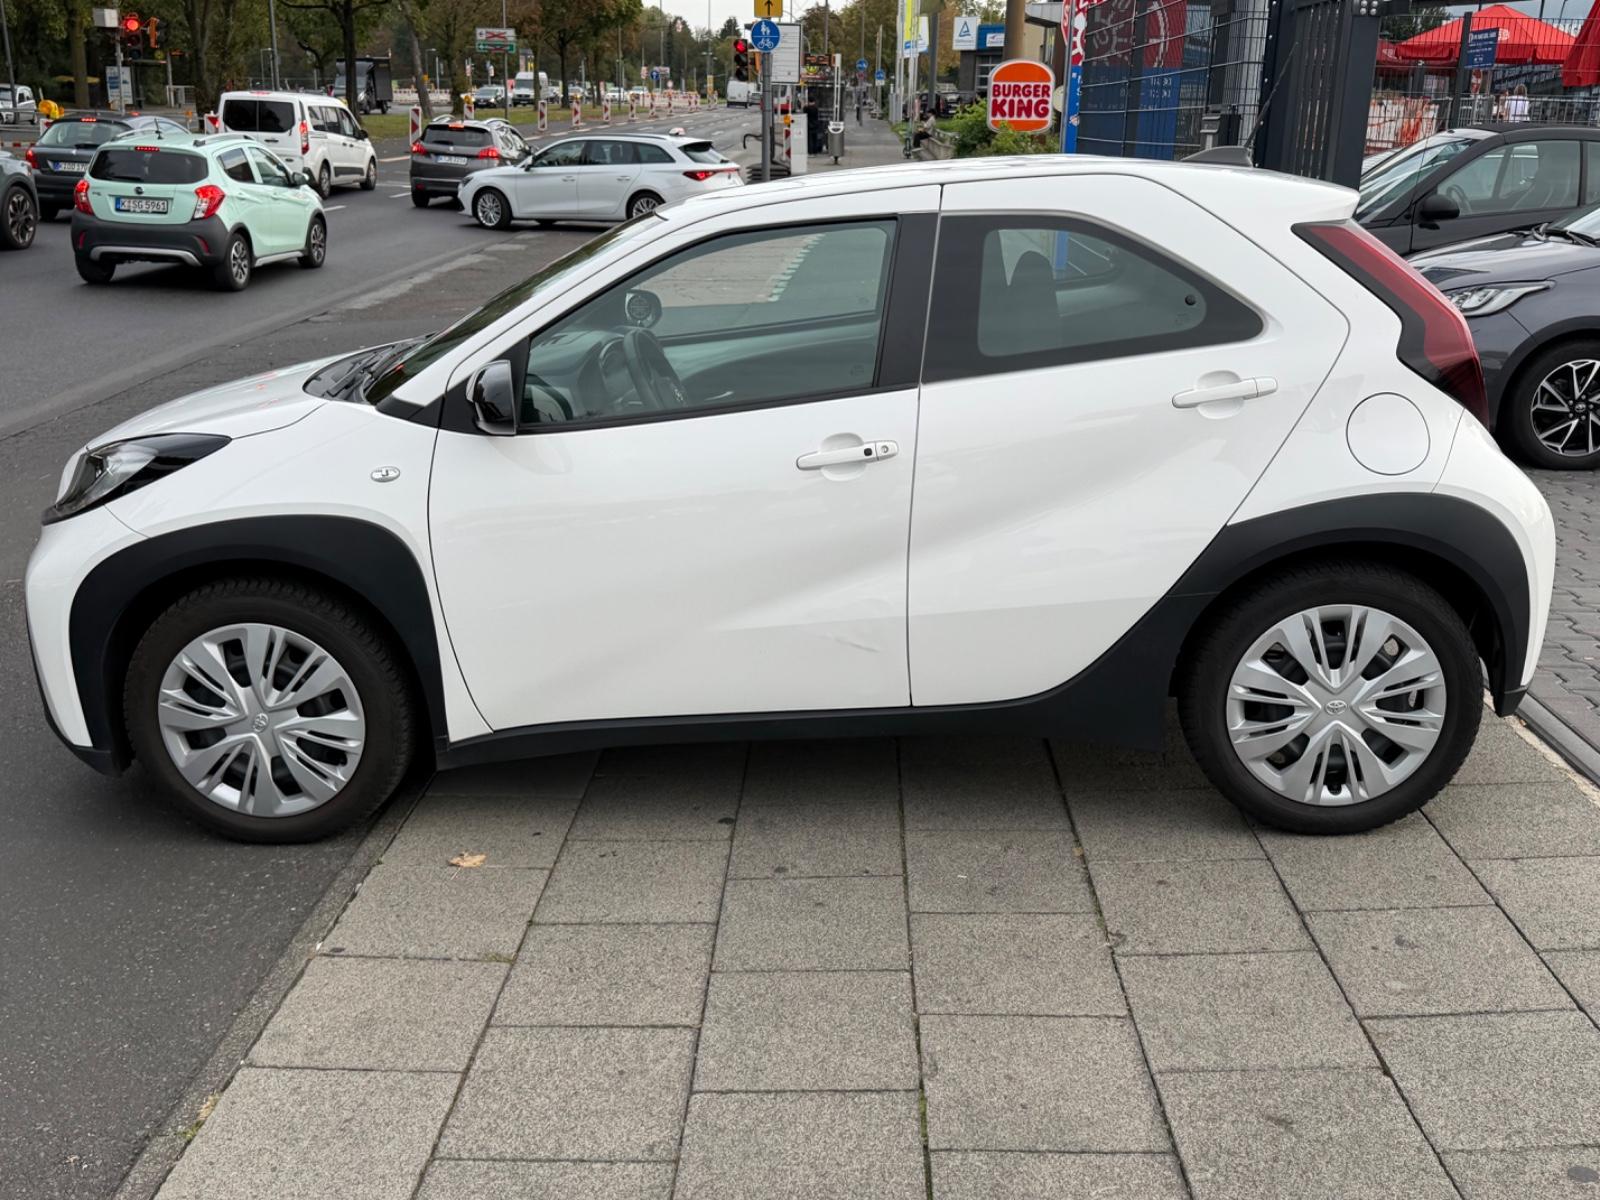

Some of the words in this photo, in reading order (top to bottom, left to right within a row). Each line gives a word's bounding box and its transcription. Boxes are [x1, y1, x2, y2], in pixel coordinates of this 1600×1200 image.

[992, 83, 1050, 98] BURGER
[991, 98, 1049, 118] KING
[145, 200, 166, 211] 5961
